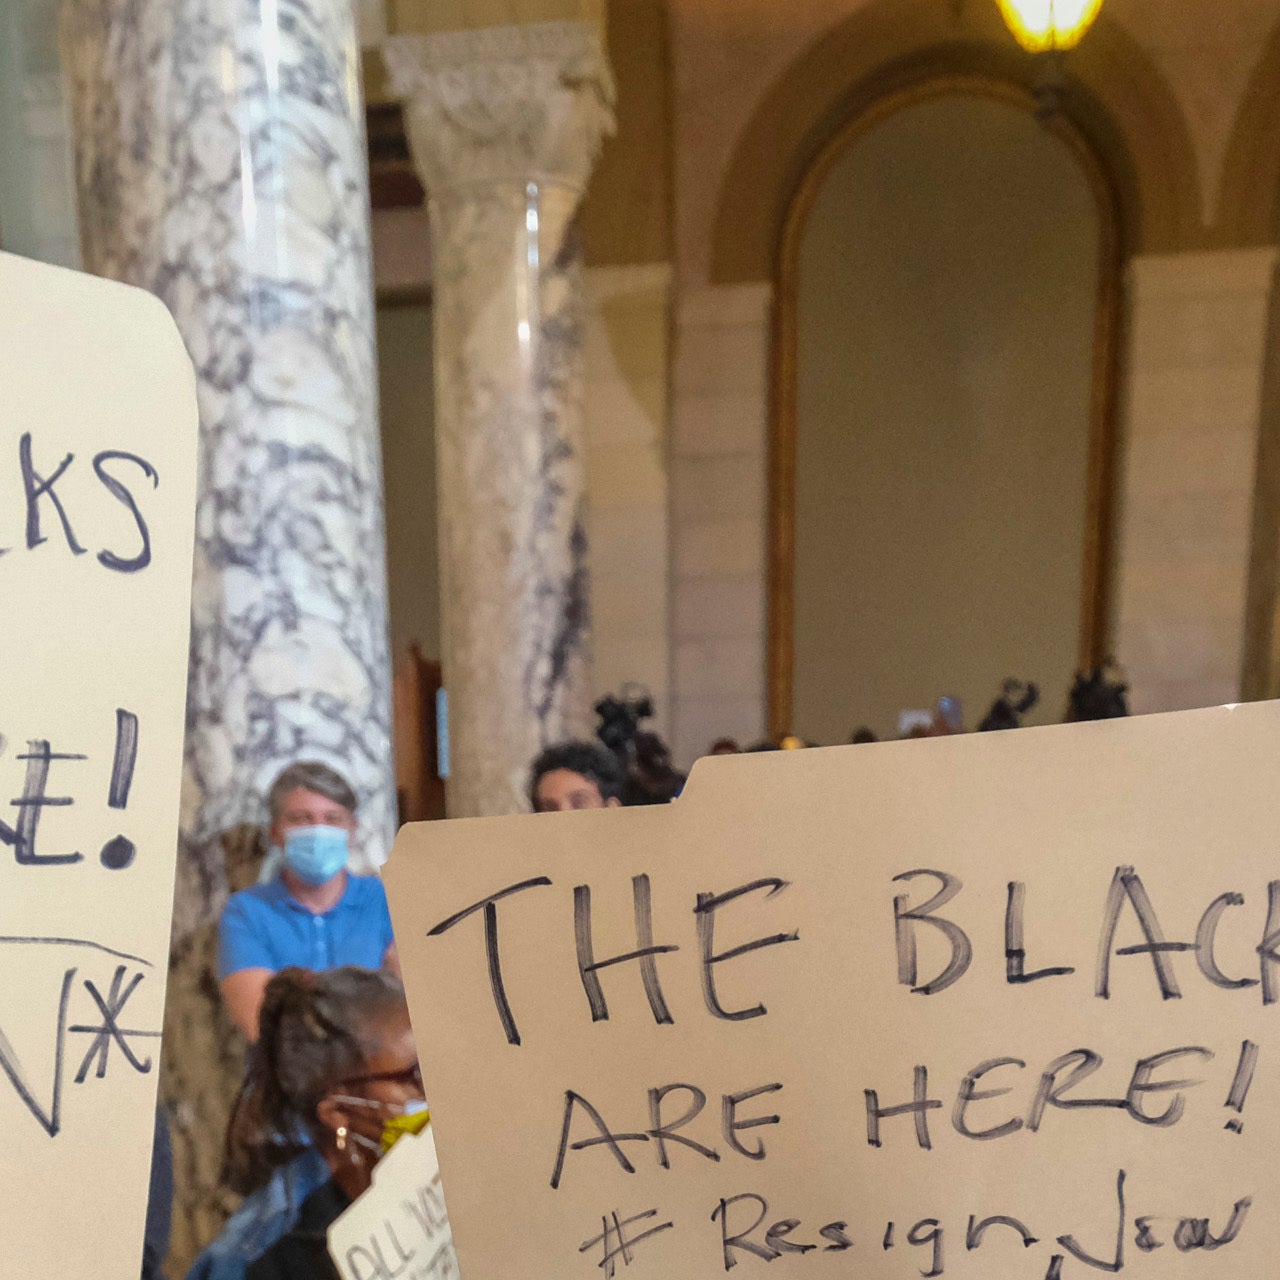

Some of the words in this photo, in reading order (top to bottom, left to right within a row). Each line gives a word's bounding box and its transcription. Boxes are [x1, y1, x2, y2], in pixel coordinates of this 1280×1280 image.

[426, 873, 801, 1046] THE
[550, 1083, 784, 1190] ARE
[863, 1038, 1260, 1151] HERE!
